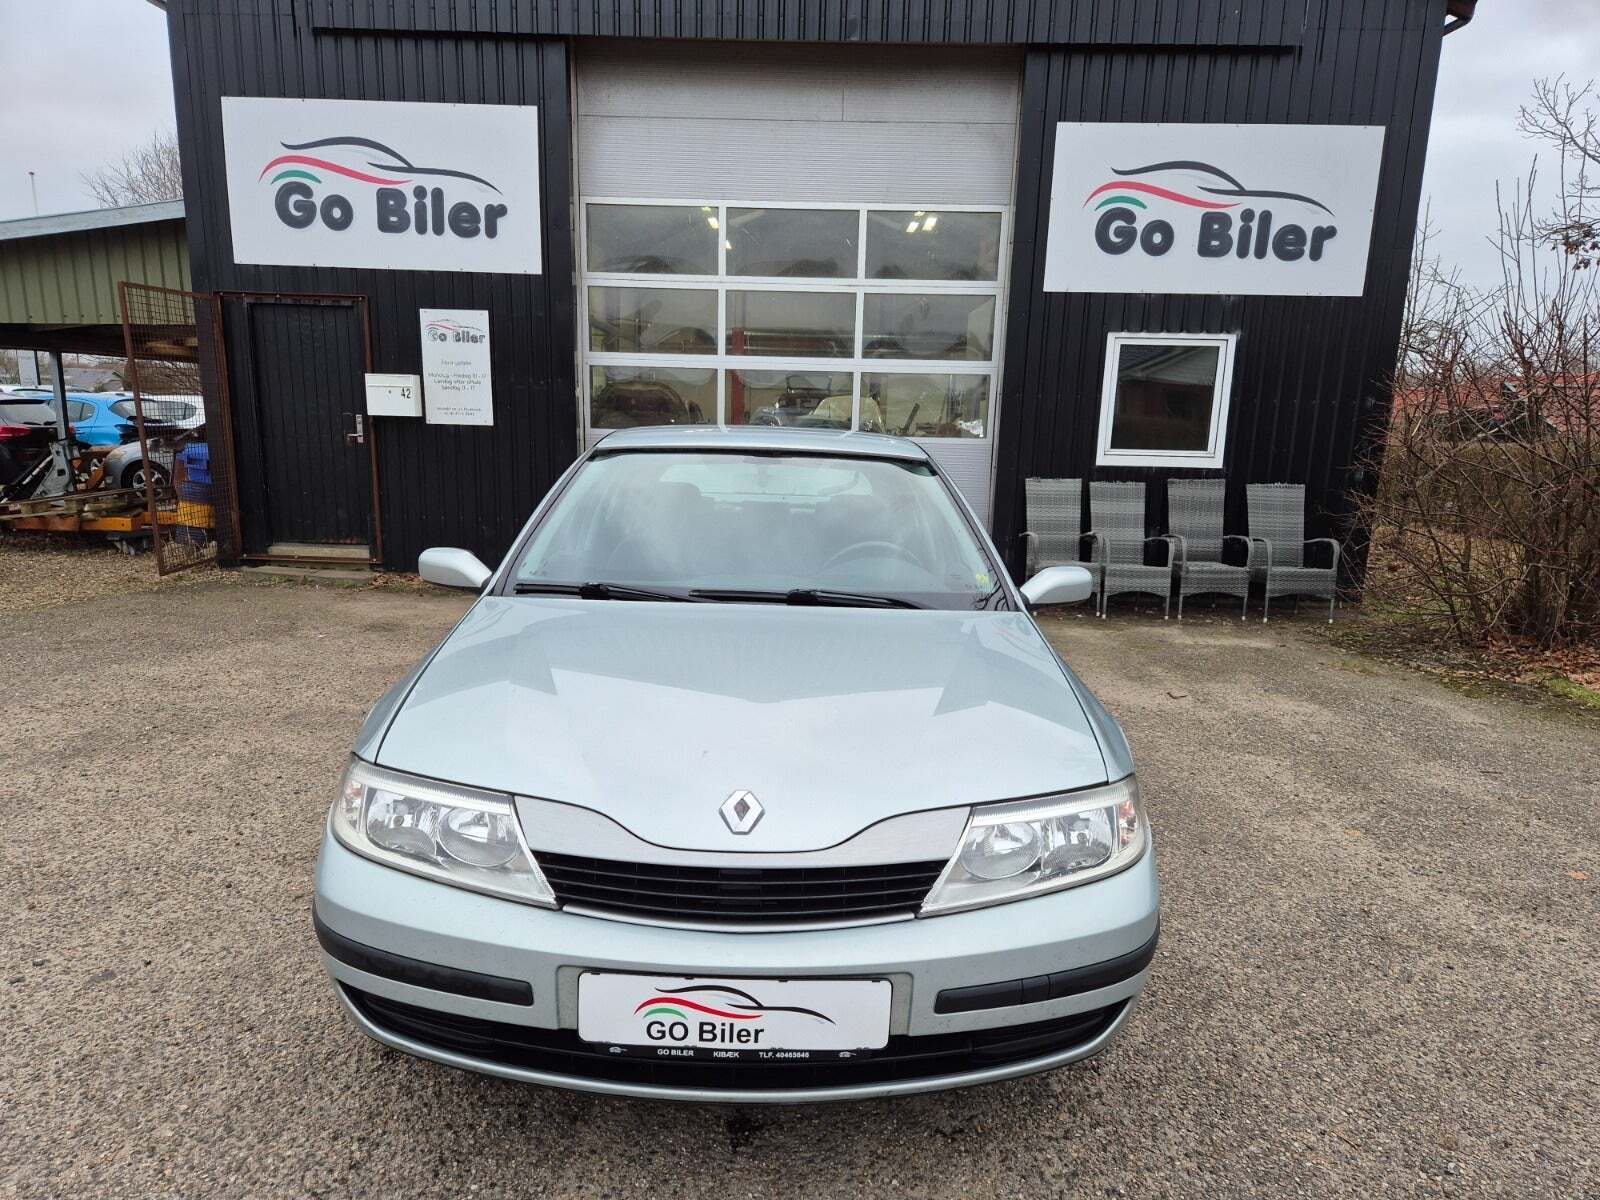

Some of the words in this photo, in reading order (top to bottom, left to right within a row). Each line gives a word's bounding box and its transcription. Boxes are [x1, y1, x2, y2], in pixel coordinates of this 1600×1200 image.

[275, 181, 354, 231] Go
[376, 185, 508, 239] Biler
[1095, 207, 1175, 256] Go
[1197, 208, 1337, 261] Biler
[453, 330, 486, 344] Biler
[401, 387, 411, 399] 42
[646, 1021, 689, 1041] GO
[698, 1021, 764, 1044] Biler
[657, 1048, 669, 1056] GO
[671, 1049, 694, 1057] BILER
